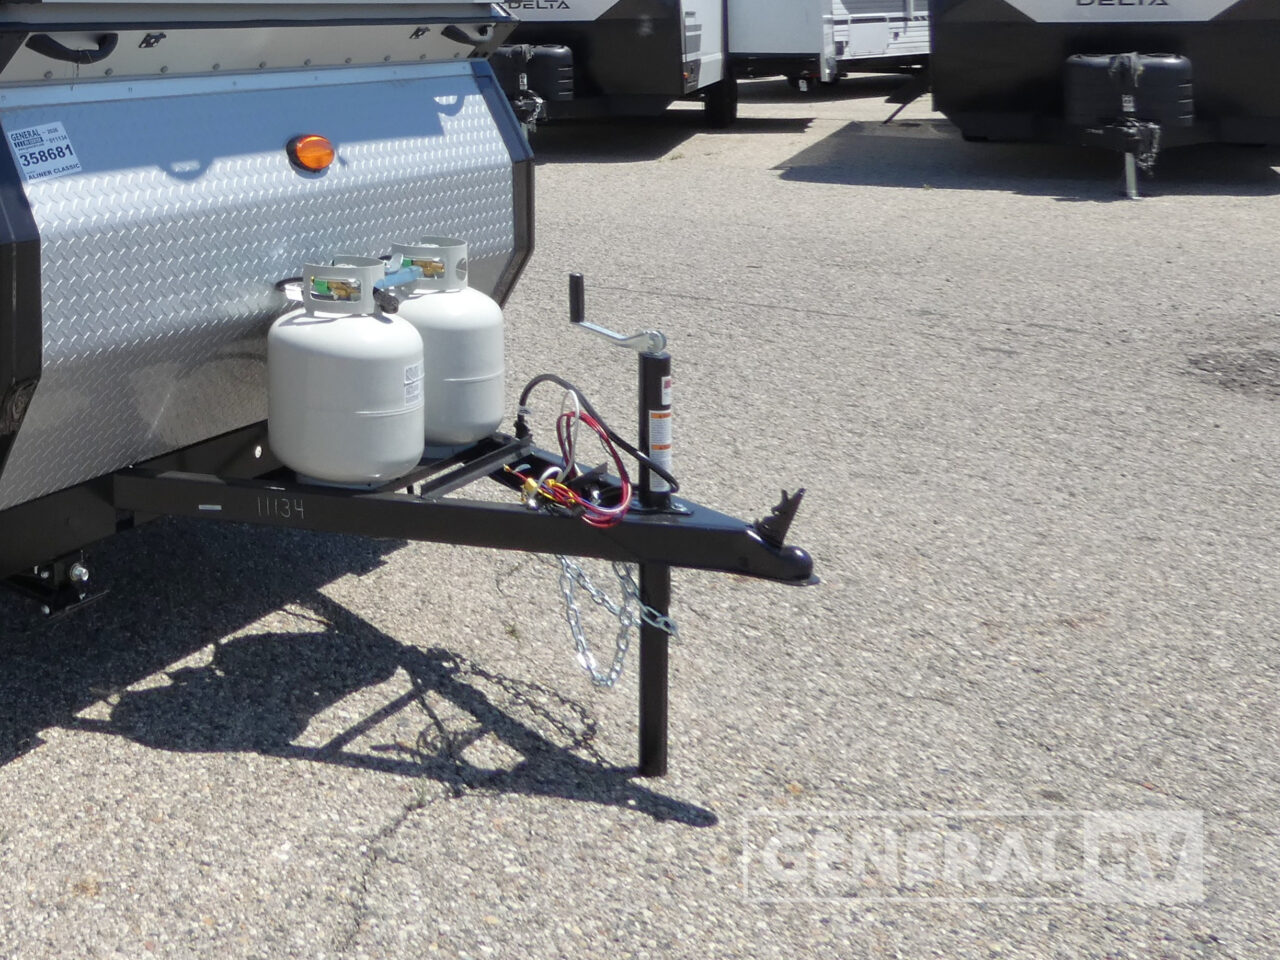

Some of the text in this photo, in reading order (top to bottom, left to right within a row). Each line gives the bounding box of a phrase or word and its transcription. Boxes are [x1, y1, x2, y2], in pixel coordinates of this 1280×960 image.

[508, 0, 570, 9] DELTA
[10, 128, 41, 141] GENERAL
[19, 144, 73, 167] 358681
[28, 163, 80, 180] ALINER CLASSIC
[257, 496, 304, 520] 11134
